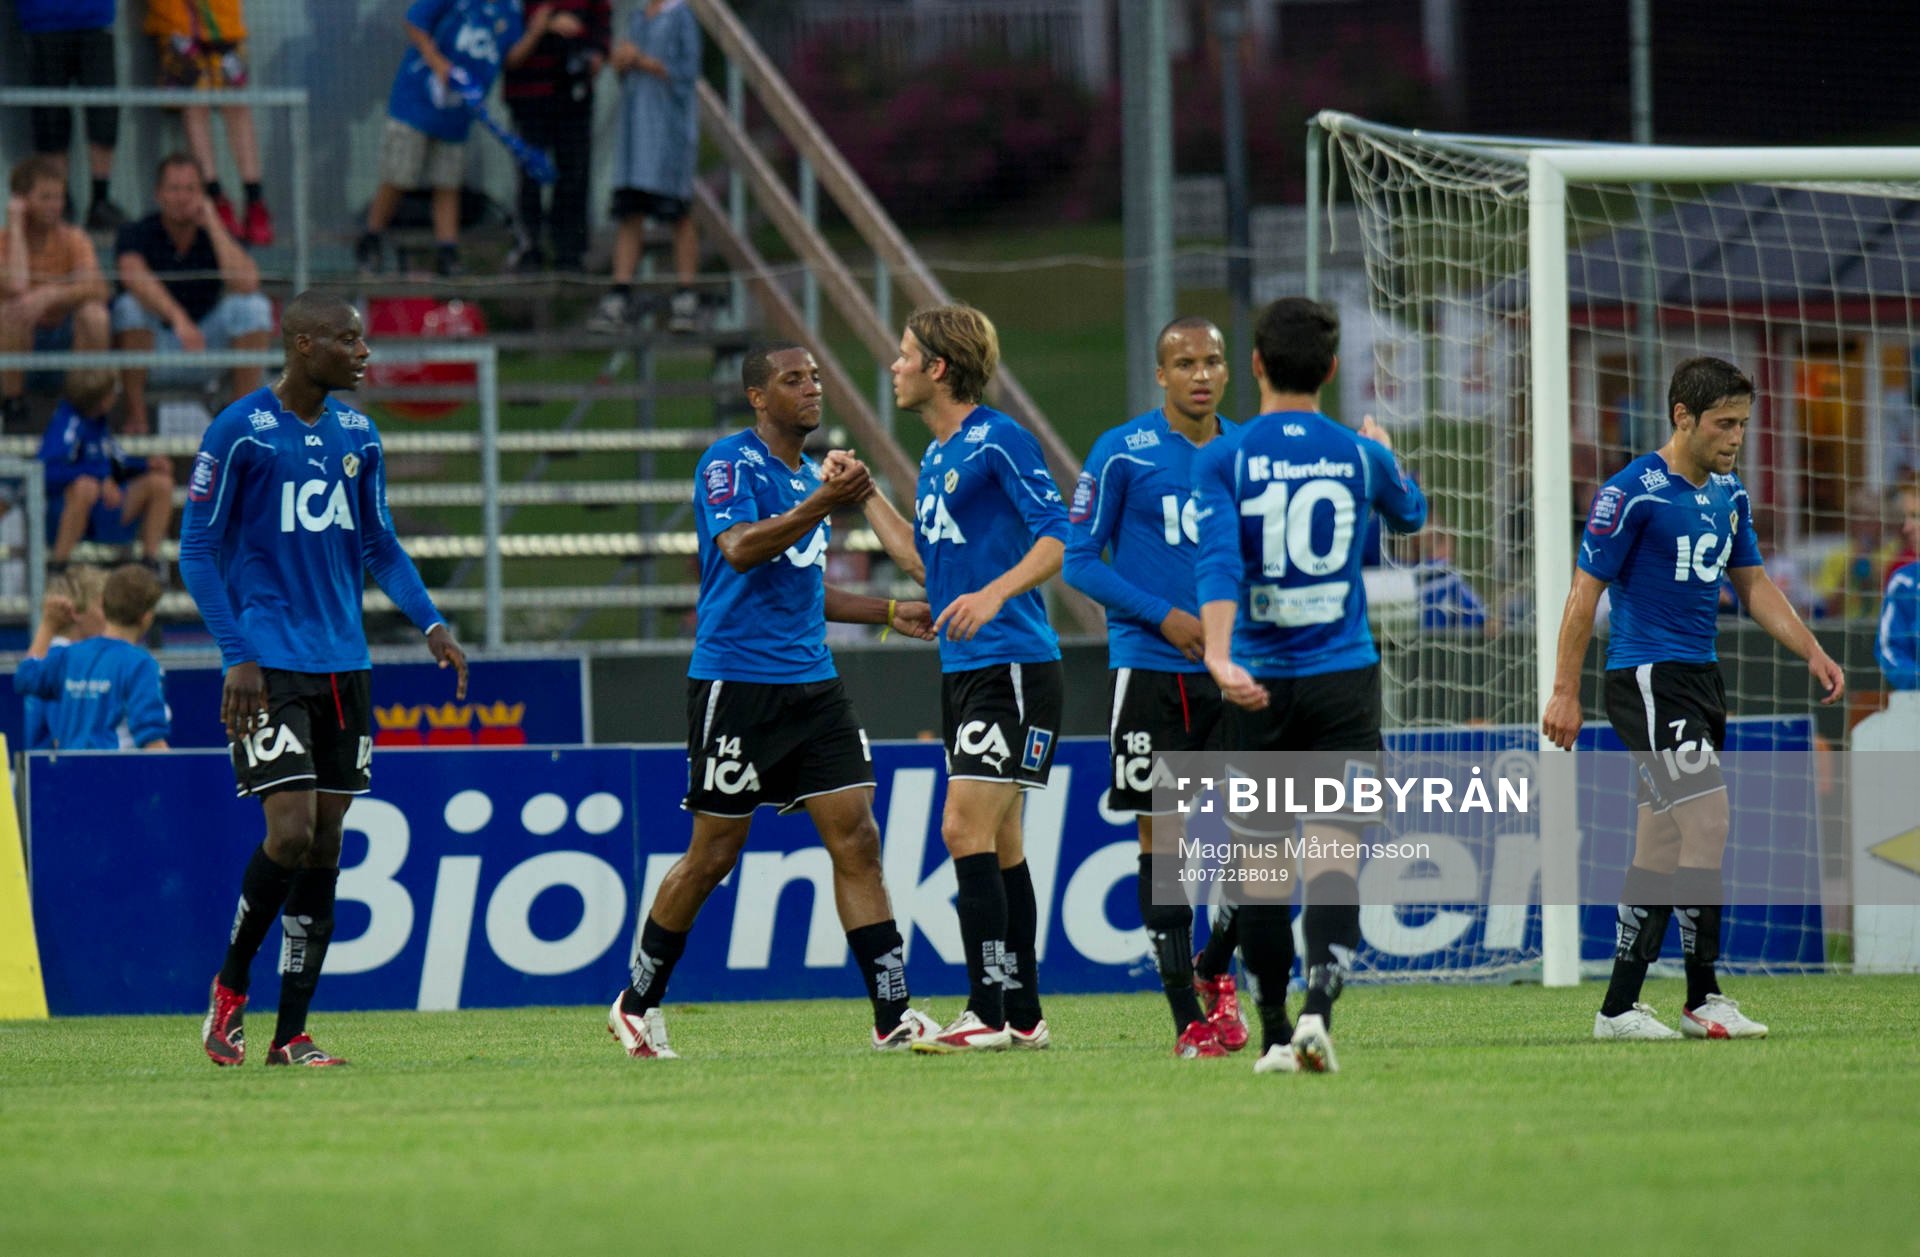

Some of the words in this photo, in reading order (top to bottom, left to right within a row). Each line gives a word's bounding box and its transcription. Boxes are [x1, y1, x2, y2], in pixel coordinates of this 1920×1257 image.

[304, 435, 323, 447] ICA
[281, 479, 355, 533] ICA
[1240, 479, 1357, 578] 10
[242, 723, 306, 768] ICA
[715, 734, 743, 760] 14
[1122, 730, 1153, 756] 18
[1668, 718, 1687, 742] 7
[703, 756, 761, 796] ICA
[1115, 755, 1179, 793] ICA
[890, 966, 908, 1002] INTER
